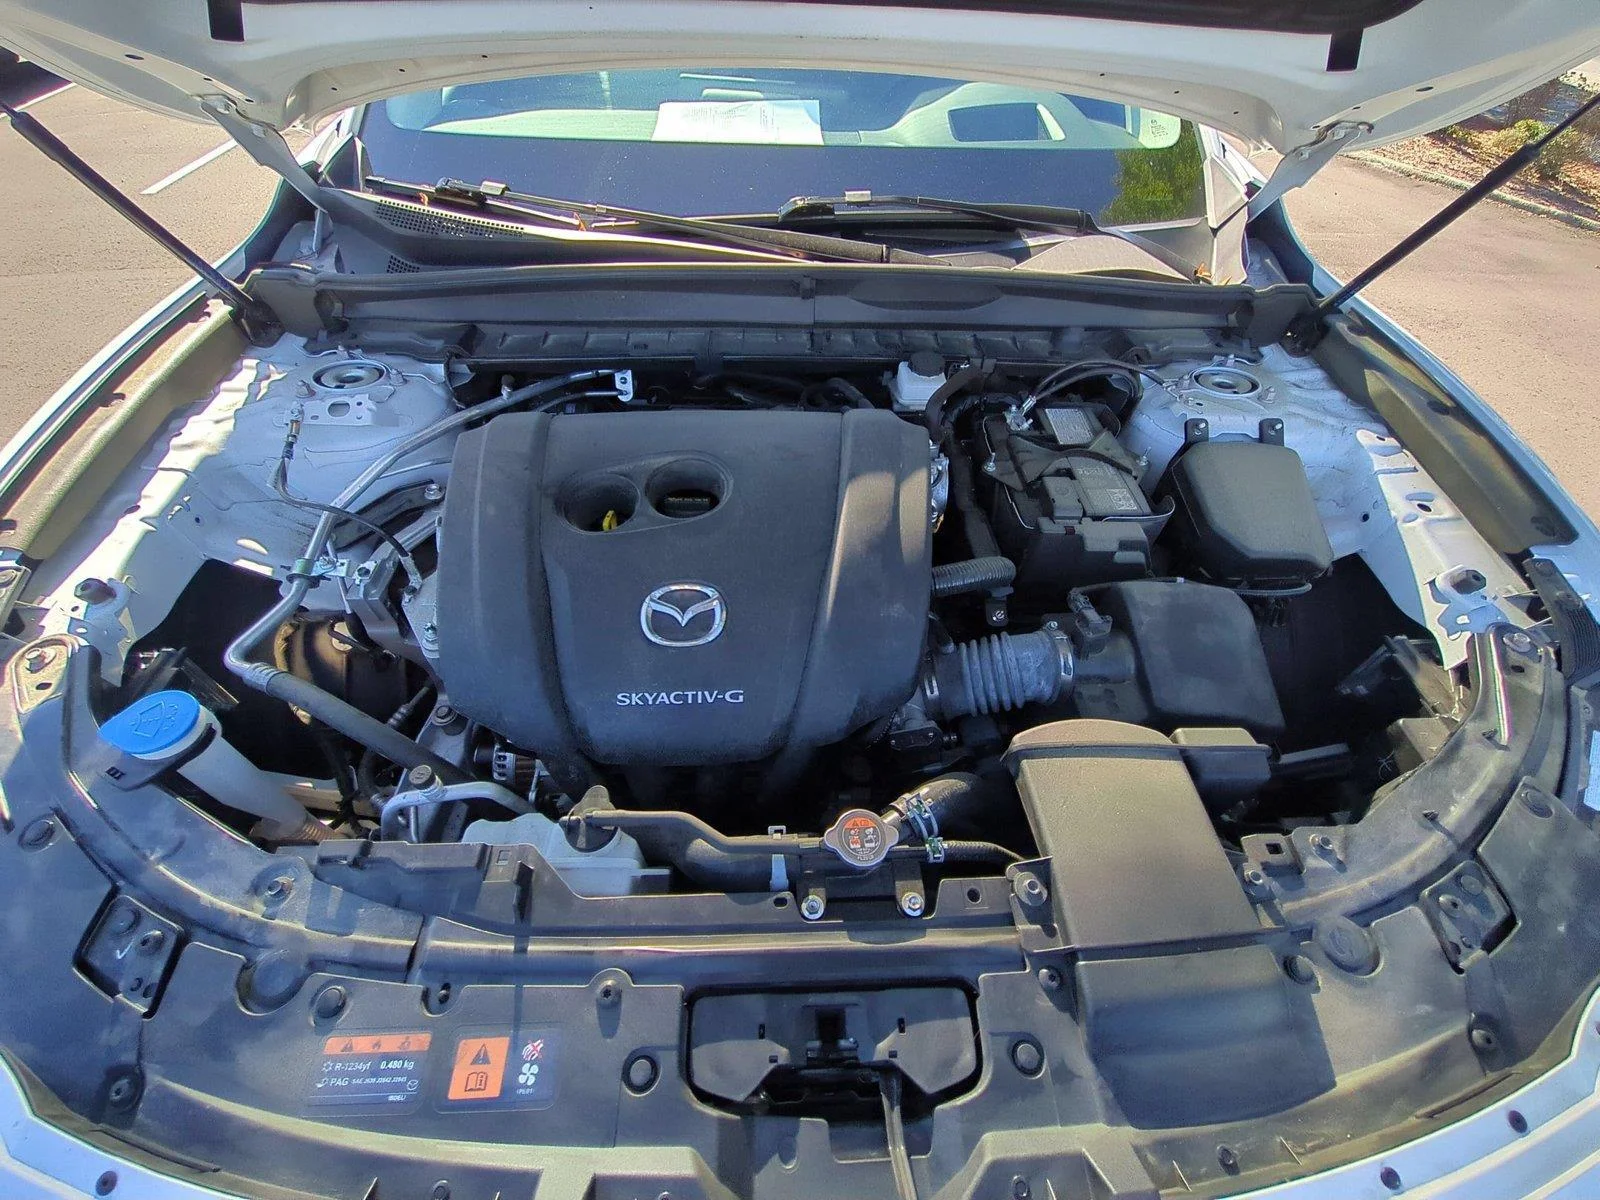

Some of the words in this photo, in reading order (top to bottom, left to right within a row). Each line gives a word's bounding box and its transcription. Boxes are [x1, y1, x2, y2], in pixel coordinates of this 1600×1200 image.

[616, 690, 744, 706] SKYACTIV-G
[334, 1061, 372, 1073] R-1234yf
[380, 1060, 403, 1070] 0.480
[403, 1059, 415, 1070] kg
[329, 1077, 349, 1087] PAG
